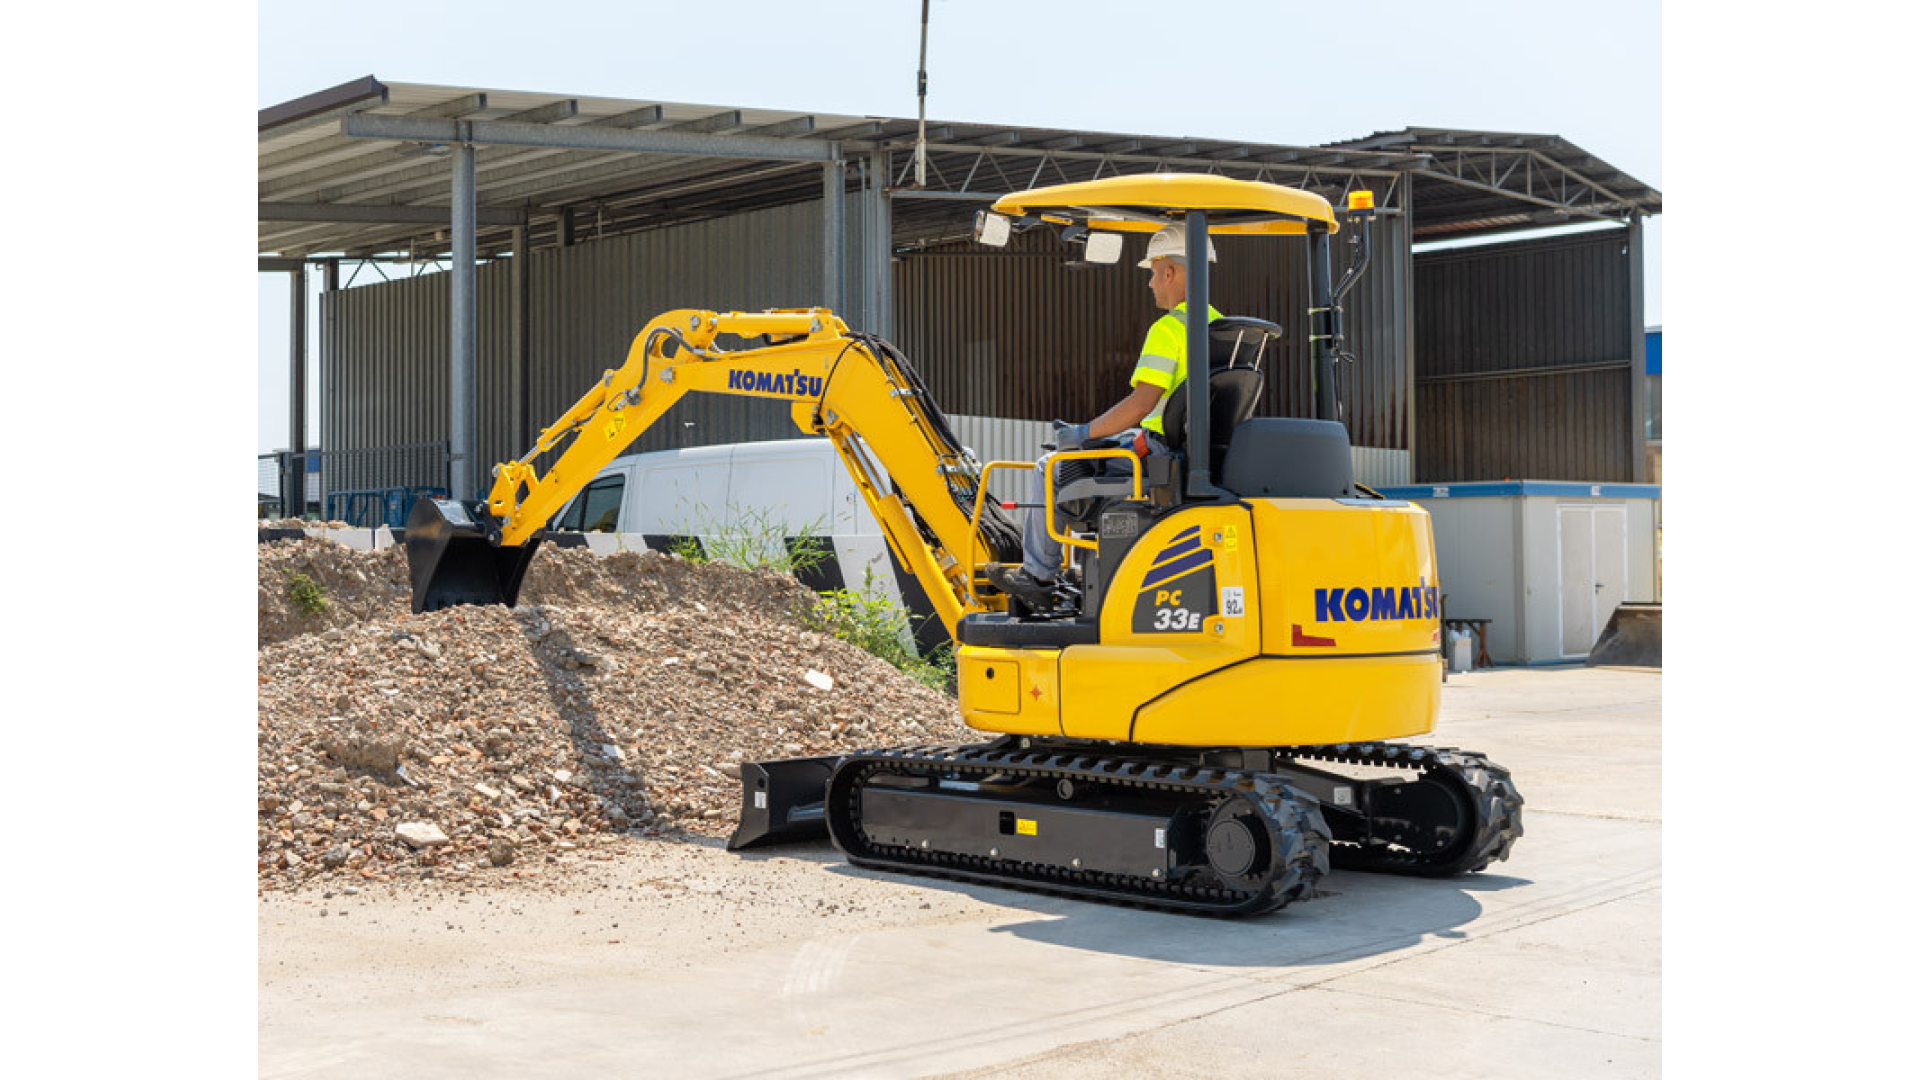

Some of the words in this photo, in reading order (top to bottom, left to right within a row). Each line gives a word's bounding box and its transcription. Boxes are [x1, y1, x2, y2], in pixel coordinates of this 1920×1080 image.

[728, 369, 823, 397] KOMATSU
[1155, 590, 1183, 606] PC
[1153, 607, 1201, 630] 33E
